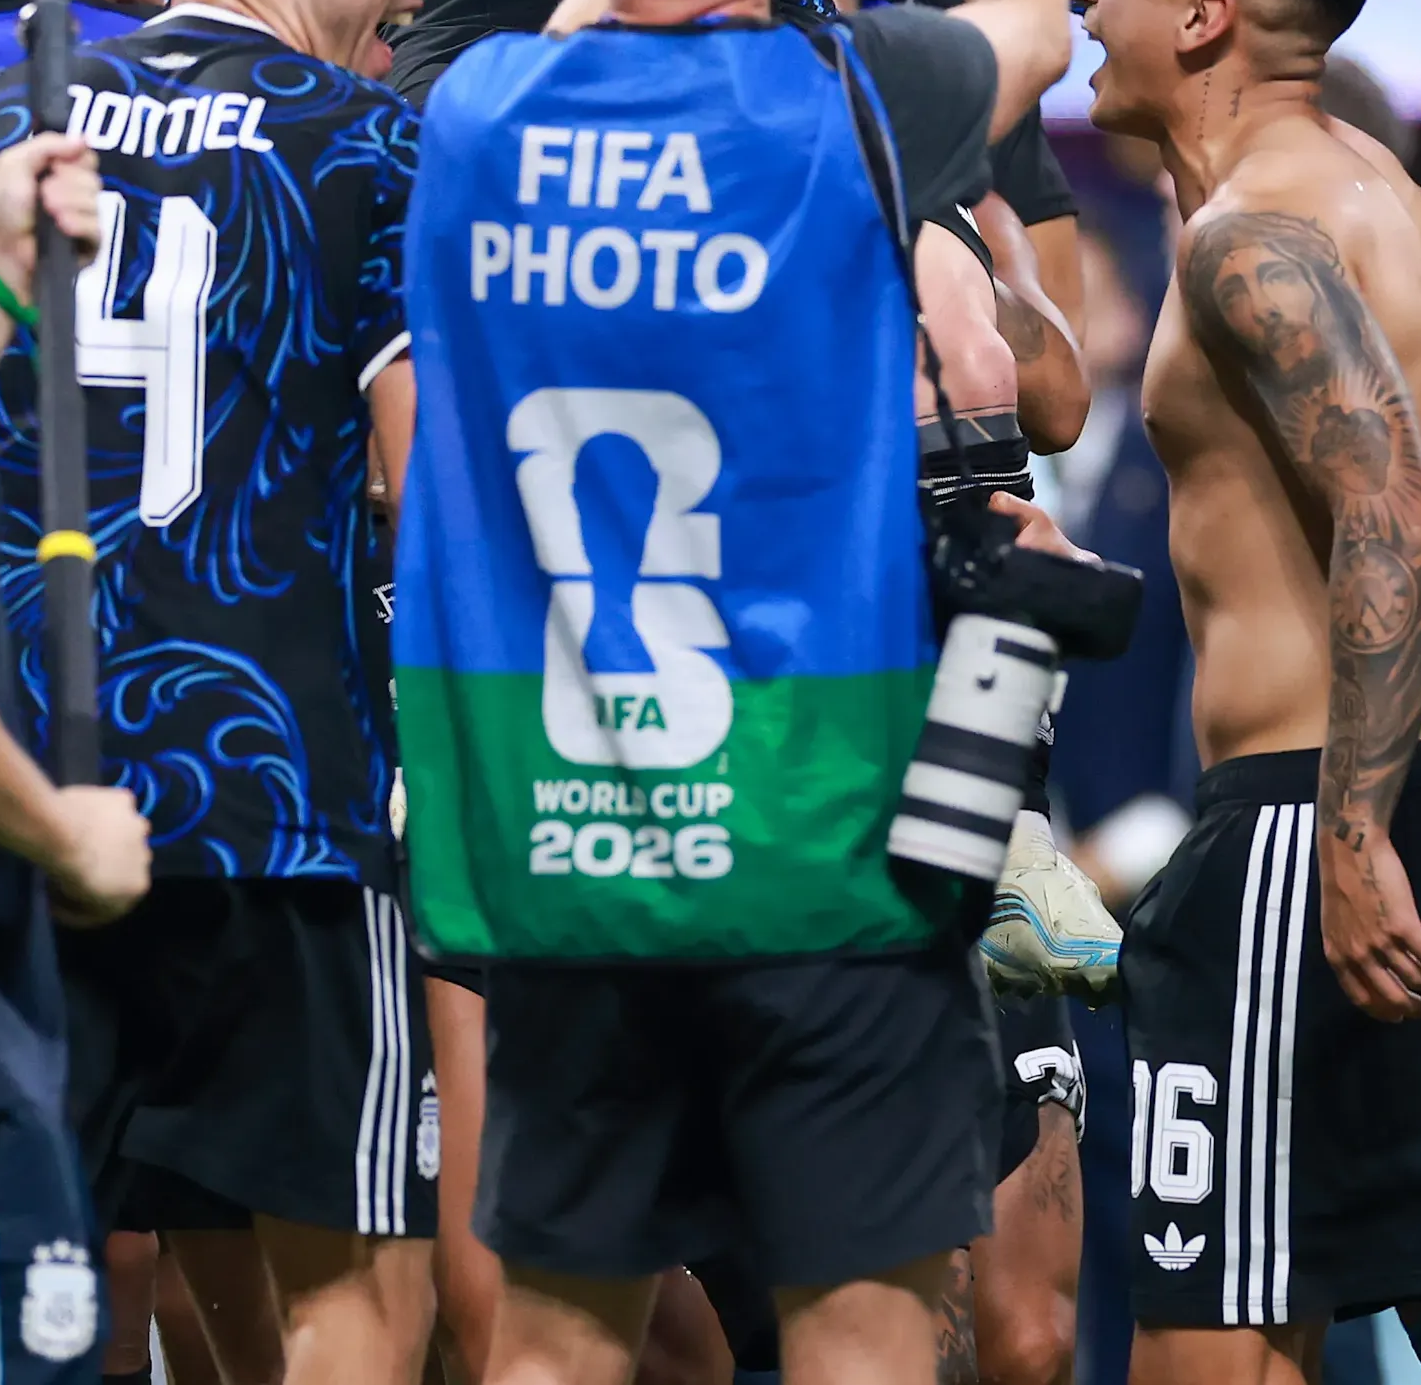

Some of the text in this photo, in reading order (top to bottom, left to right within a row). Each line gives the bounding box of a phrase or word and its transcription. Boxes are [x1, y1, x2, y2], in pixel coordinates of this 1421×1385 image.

[517, 124, 712, 213] FIFA
[470, 221, 769, 314] PHOTO
[74, 190, 217, 527] 4
[650, 782, 734, 819] CUP
[529, 819, 734, 880] 2026
[1131, 1059, 1218, 1204] 16
